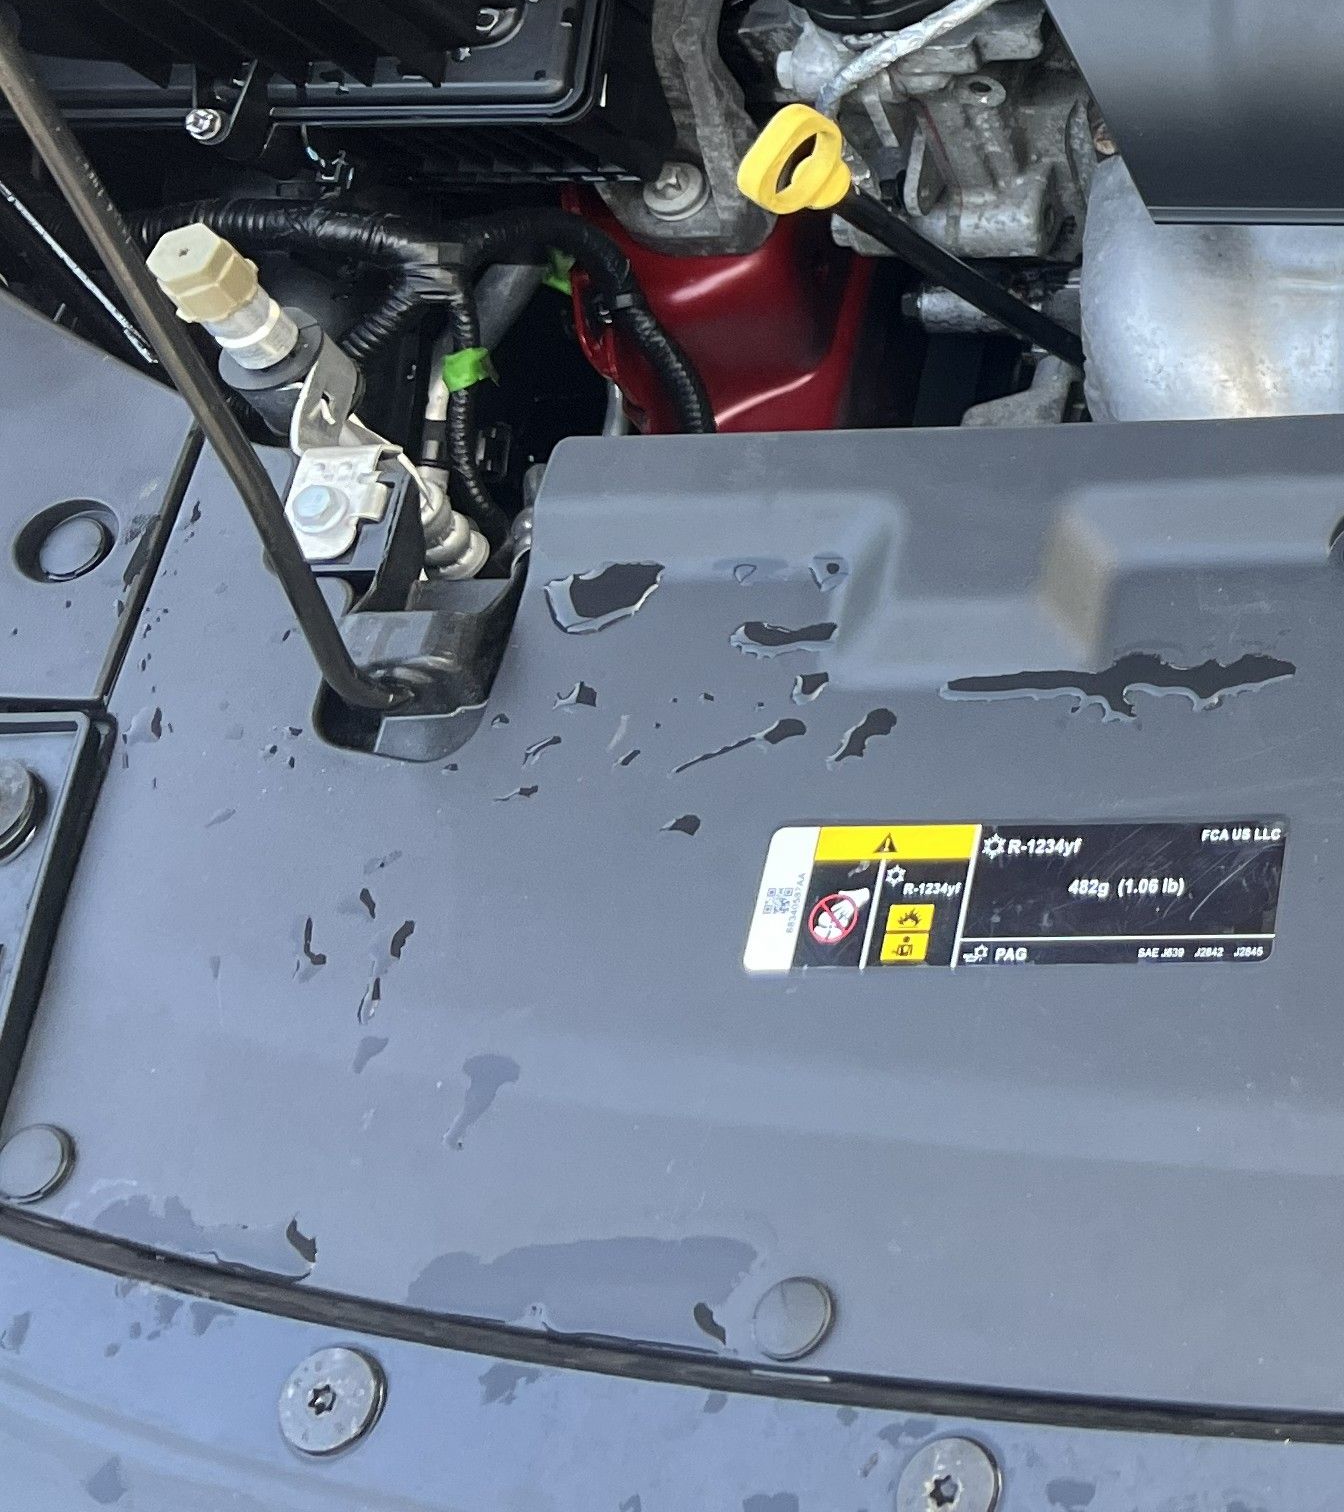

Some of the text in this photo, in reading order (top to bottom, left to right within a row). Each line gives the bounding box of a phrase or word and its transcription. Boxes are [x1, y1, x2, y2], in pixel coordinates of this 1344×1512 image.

[1201, 827, 1281, 842] FCA US LLC
[1007, 838, 1082, 857] R-1234yf
[902, 882, 962, 897] R-1234yf
[1068, 878, 1185, 898] 482g (1.06 lb)
[994, 947, 1027, 961] PAG
[1138, 947, 1159, 958] SAE
